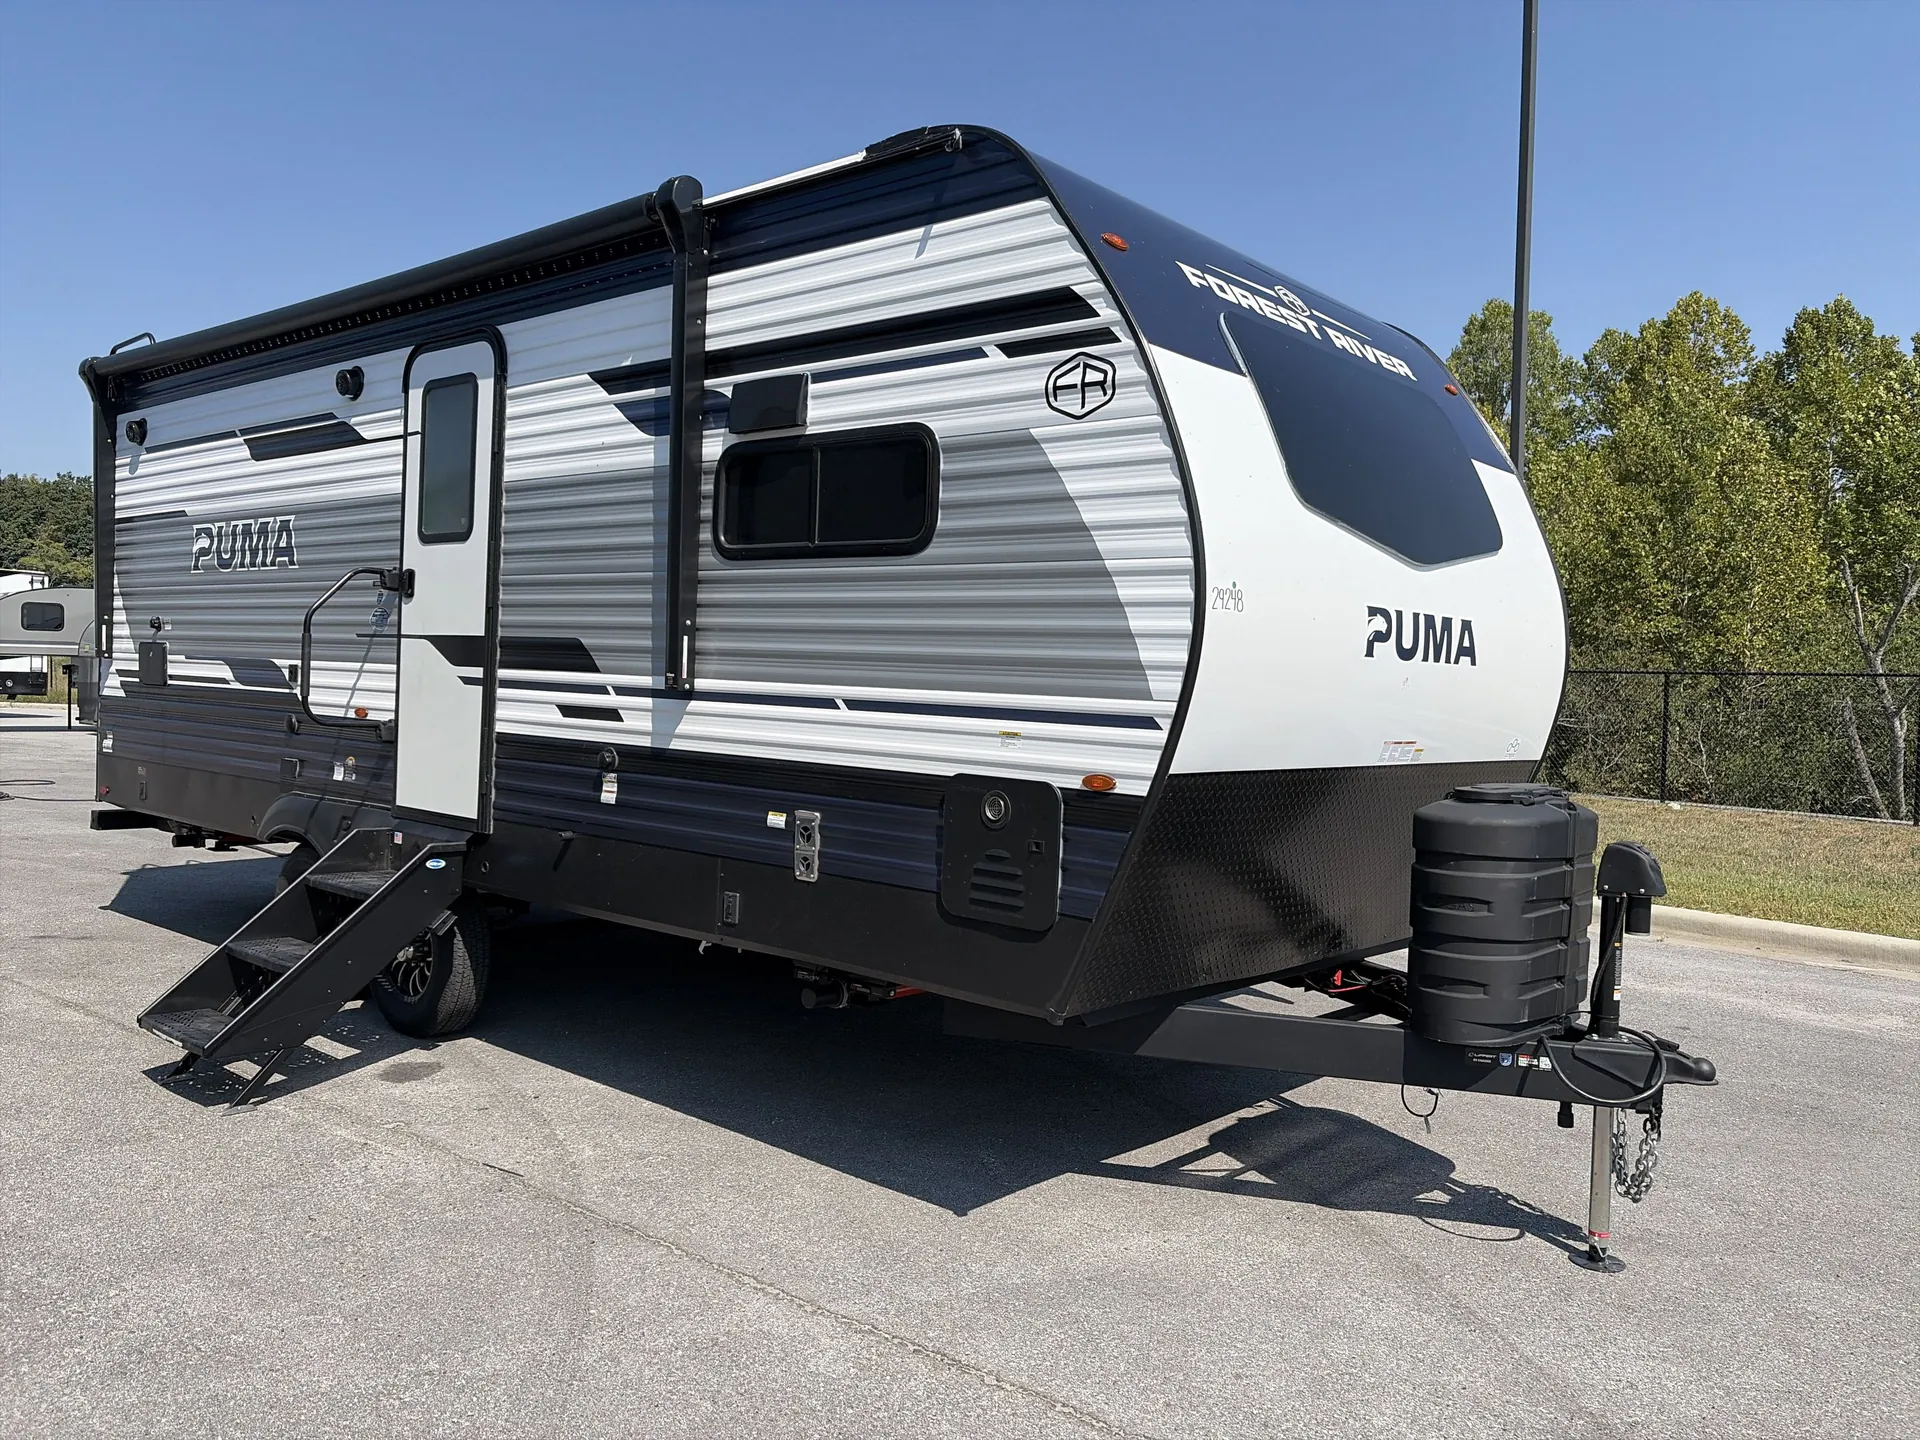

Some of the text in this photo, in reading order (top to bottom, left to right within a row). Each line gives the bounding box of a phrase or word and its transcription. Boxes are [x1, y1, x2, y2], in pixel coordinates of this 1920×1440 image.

[1175, 260, 1418, 381] FOREST RIVER
[191, 515, 299, 573] PUMA
[1212, 586, 1244, 612] 29248
[1364, 605, 1477, 667] PUMA
